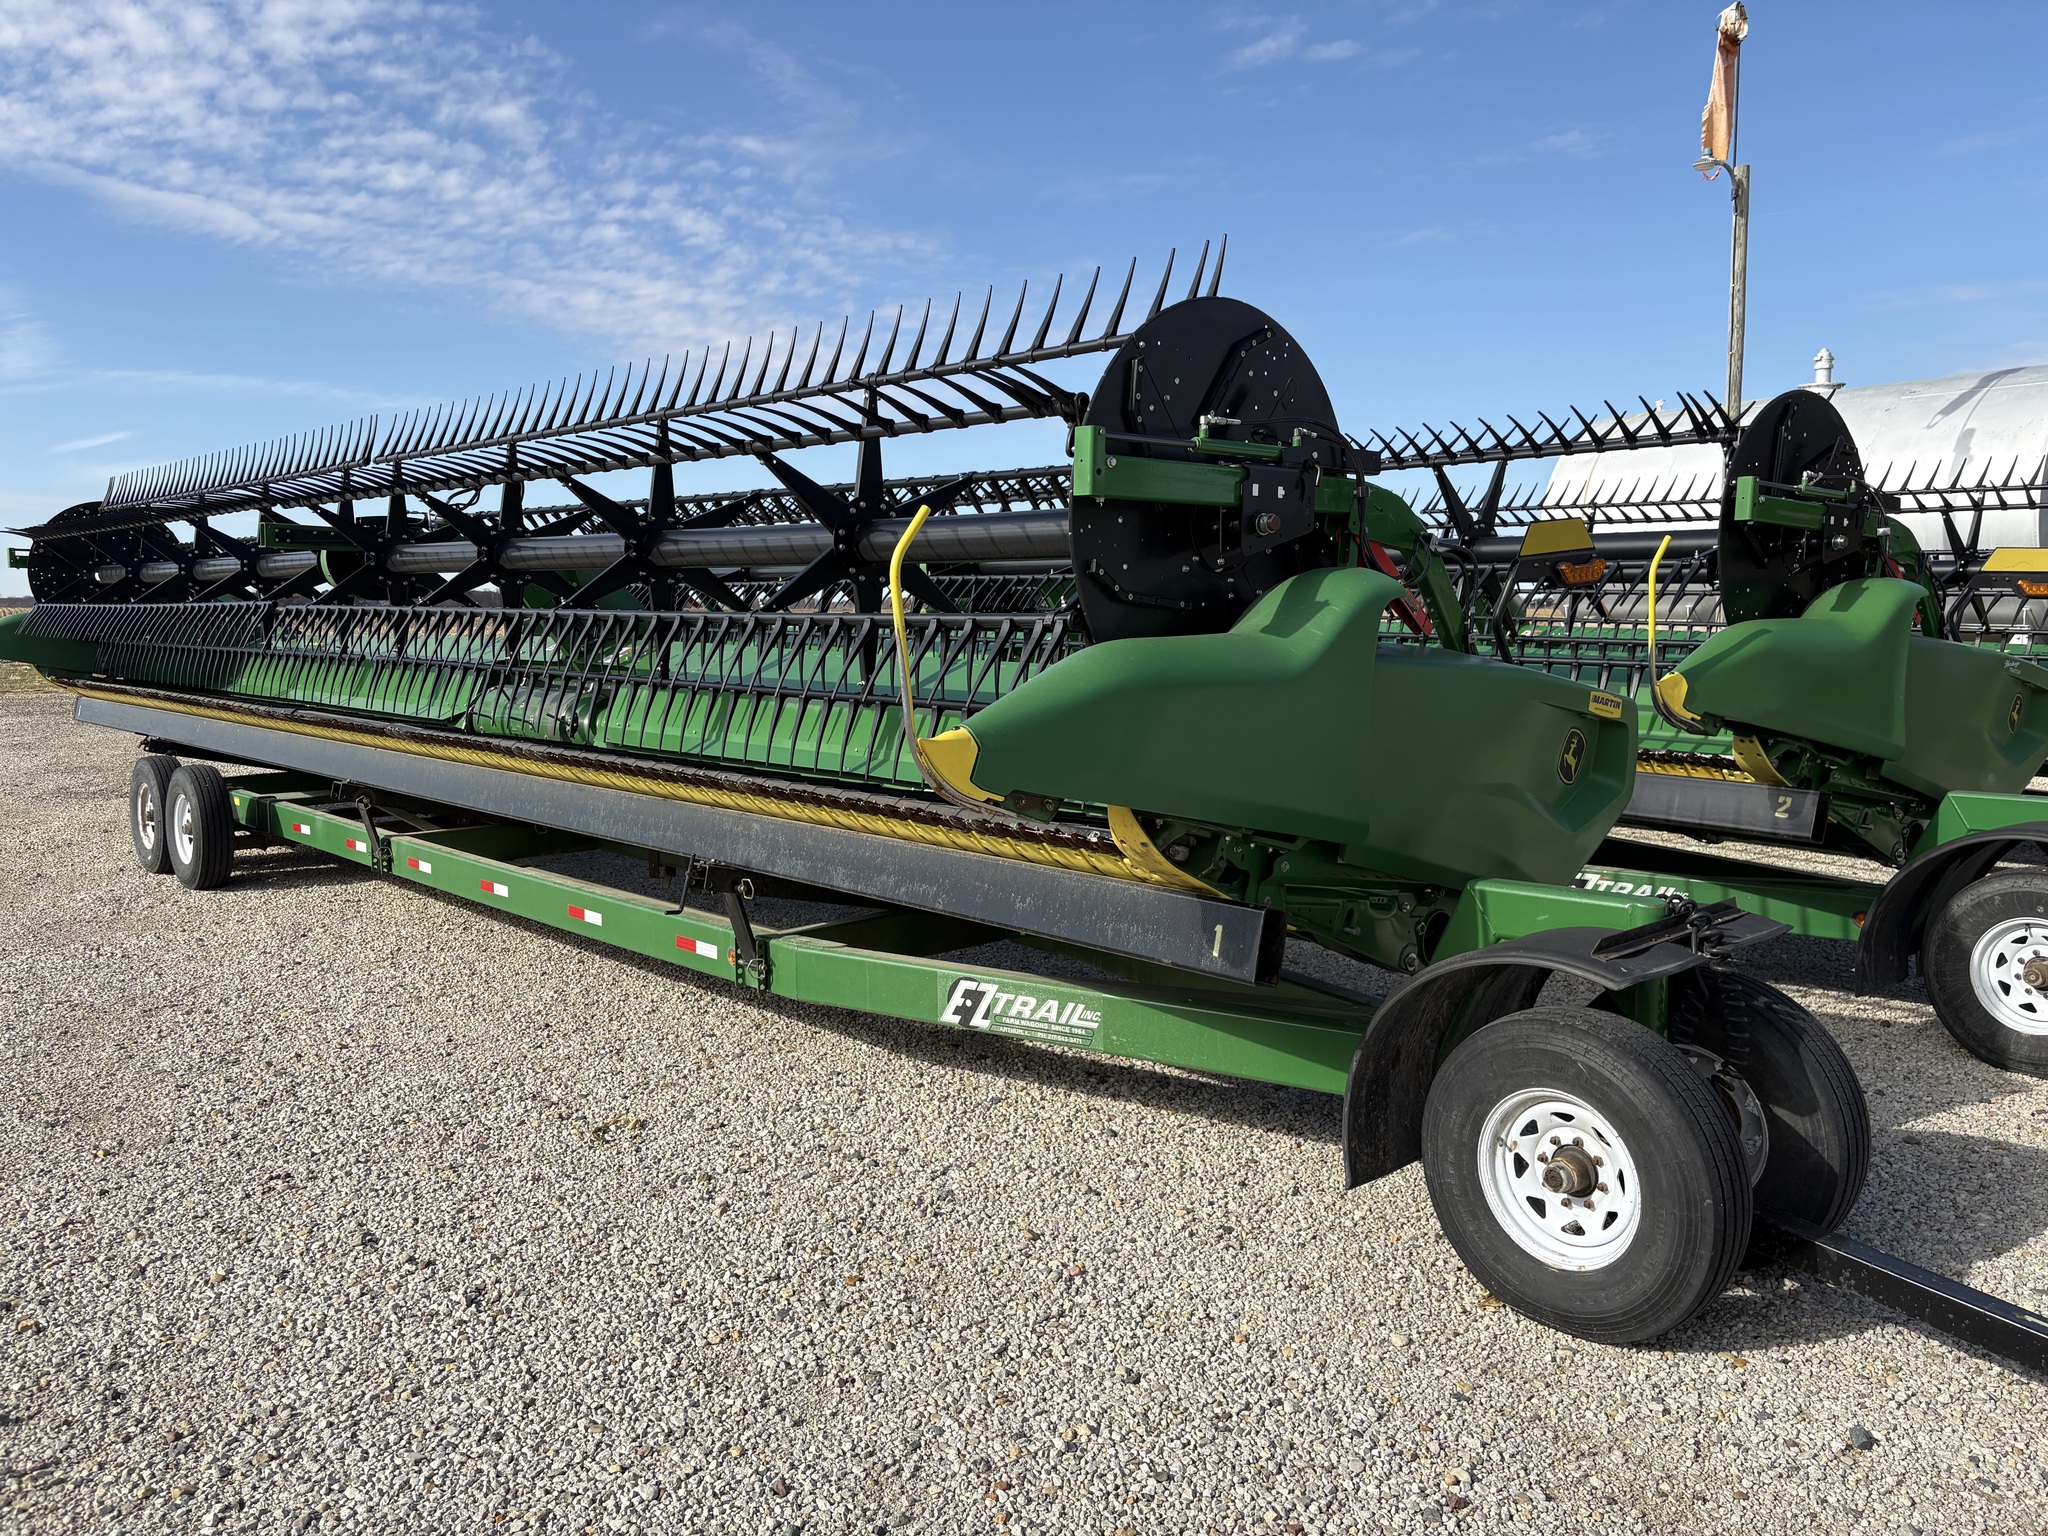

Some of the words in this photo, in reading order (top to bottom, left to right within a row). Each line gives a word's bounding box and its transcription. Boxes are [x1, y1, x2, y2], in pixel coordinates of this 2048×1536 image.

[1593, 694, 1621, 709] MARTIN
[1774, 795, 1792, 818] 2
[1212, 924, 1223, 957] 1
[993, 992, 1099, 1029] TRAIL
